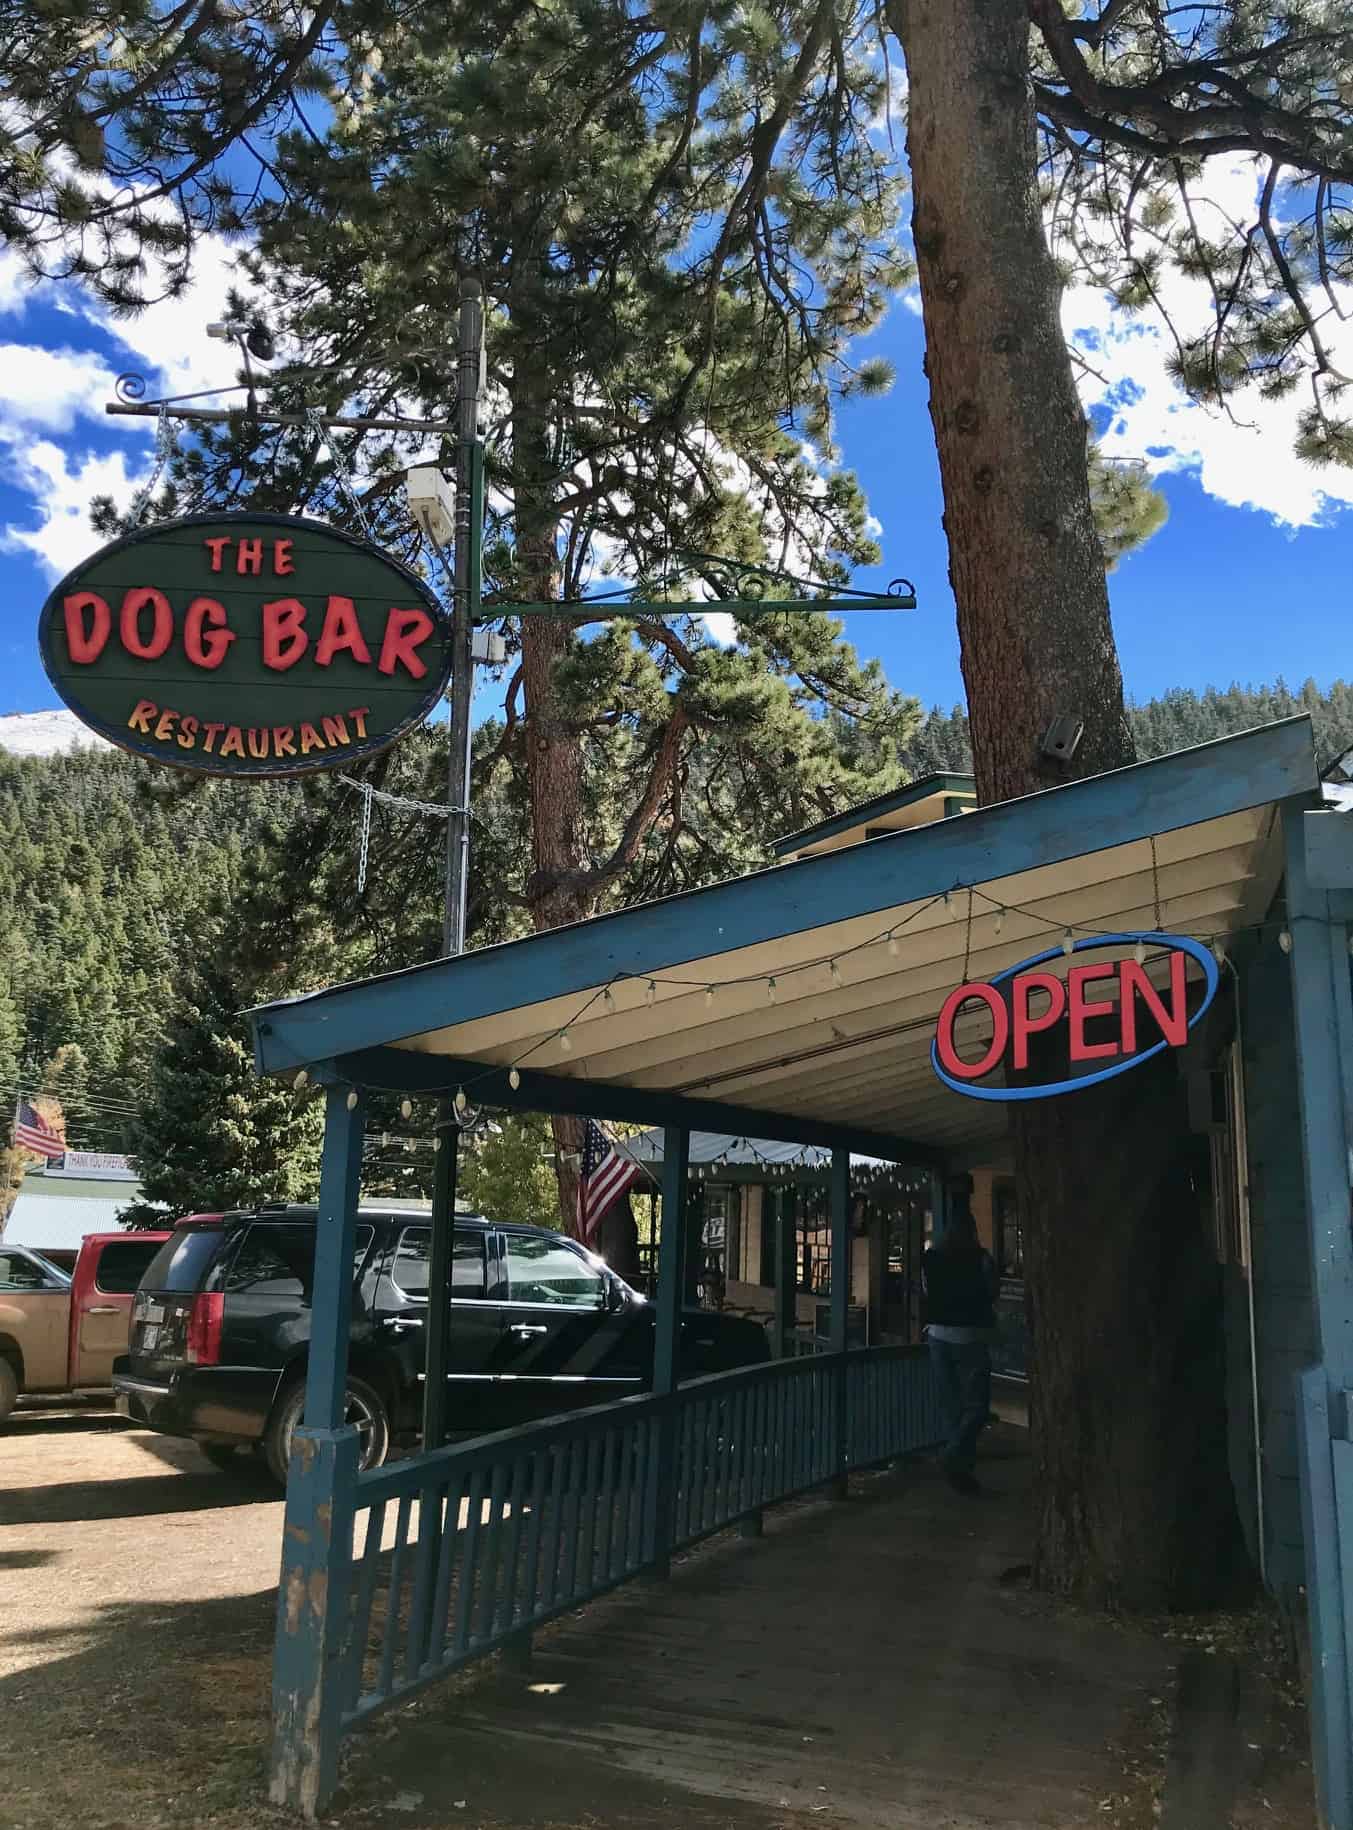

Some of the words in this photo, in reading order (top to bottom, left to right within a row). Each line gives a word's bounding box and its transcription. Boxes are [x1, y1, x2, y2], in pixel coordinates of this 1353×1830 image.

[205, 537, 295, 575] THE
[63, 587, 236, 670] DOG
[262, 594, 435, 679] BAR
[128, 700, 370, 760] RESTAURANT
[936, 951, 1188, 1078] OPEN
